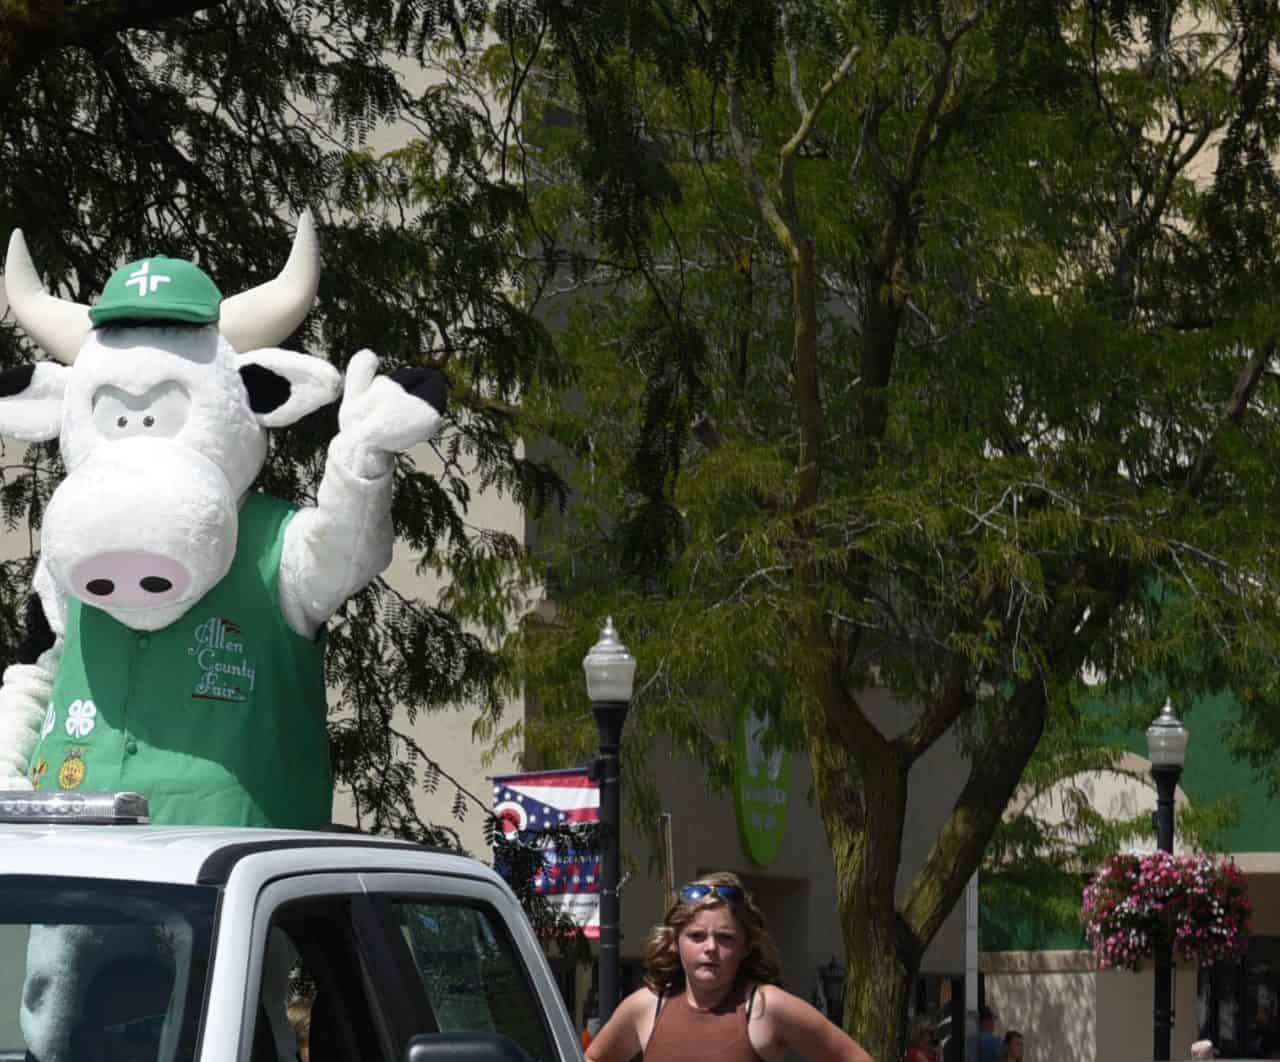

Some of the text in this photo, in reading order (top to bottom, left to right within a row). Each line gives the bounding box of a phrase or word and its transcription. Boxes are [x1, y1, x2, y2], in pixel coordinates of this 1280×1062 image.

[187, 617, 243, 655] Allen
[195, 671, 235, 697] Fair
[198, 648, 256, 691] County
